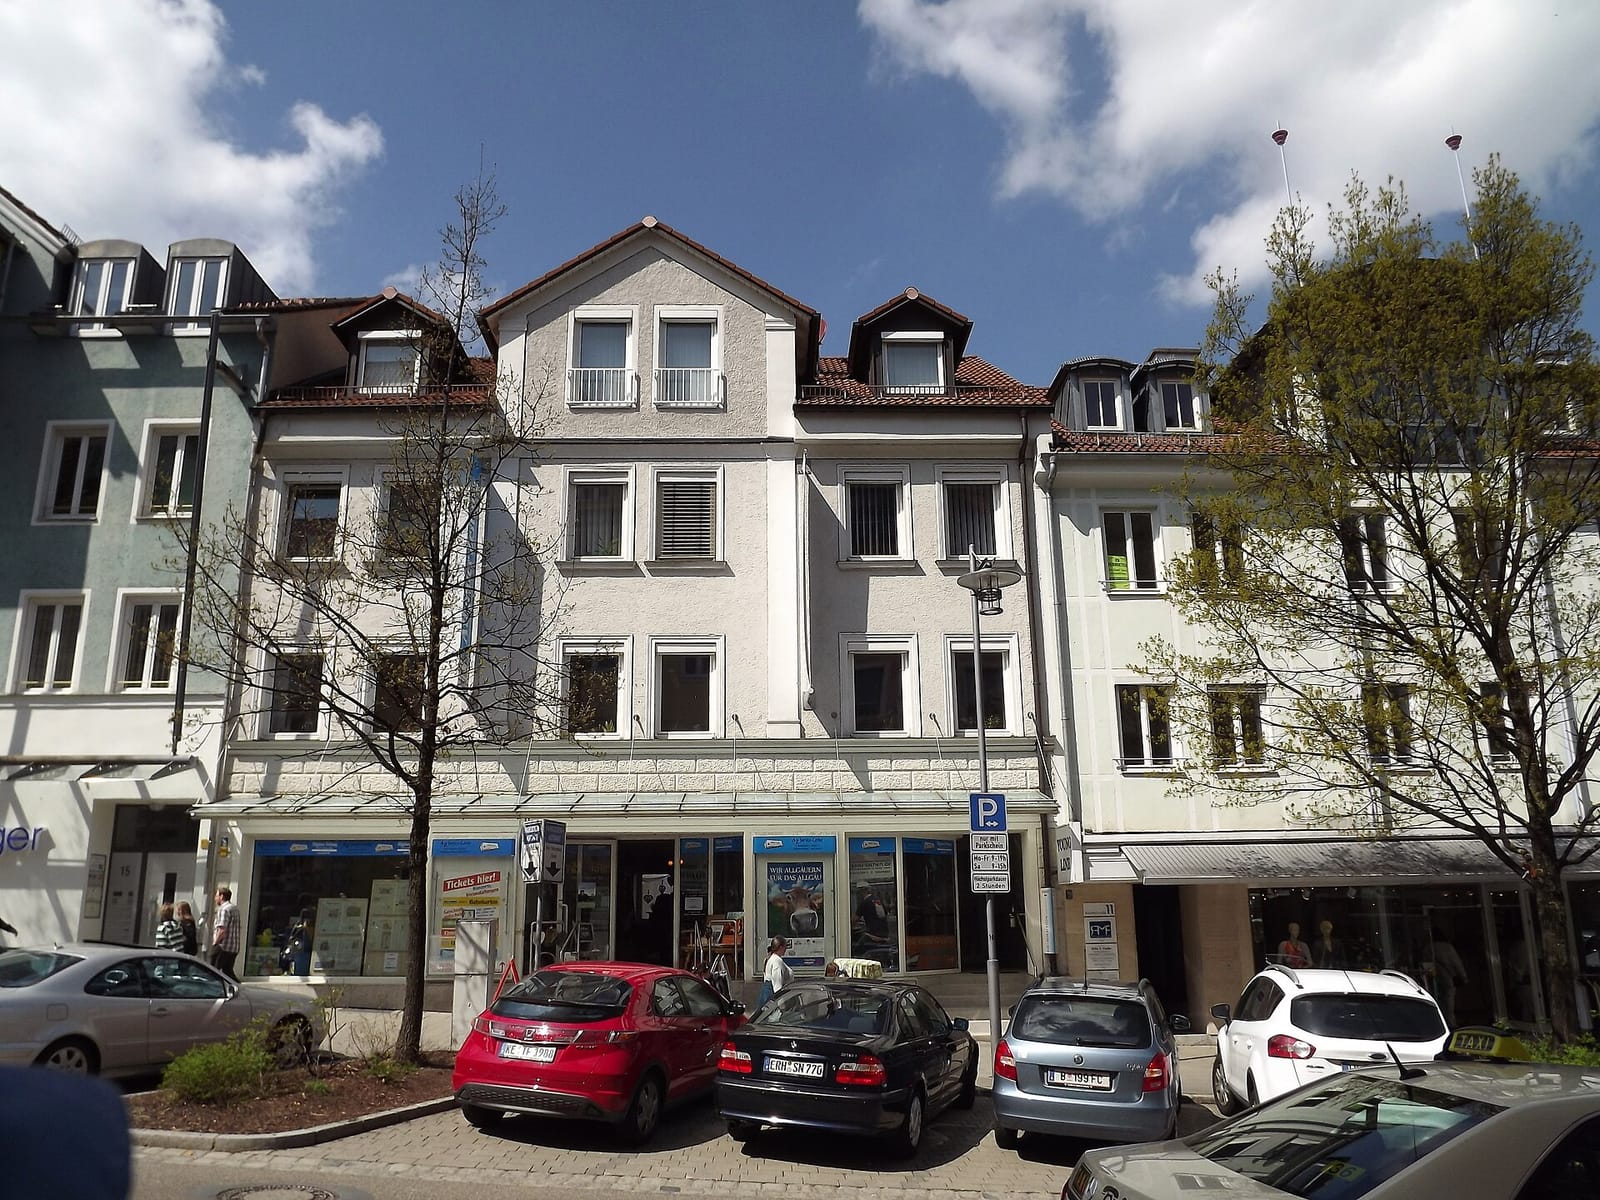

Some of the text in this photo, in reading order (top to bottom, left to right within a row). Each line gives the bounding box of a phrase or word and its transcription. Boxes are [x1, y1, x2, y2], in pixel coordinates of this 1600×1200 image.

[978, 797, 998, 827] P
[0, 827, 43, 855] er
[1056, 835, 1072, 851] YOUNG
[120, 865, 131, 877] 15
[446, 878, 475, 889] Tickets
[477, 872, 496, 884] hier!
[1105, 904, 1114, 915] 11
[1460, 1034, 1490, 1051] TAXI
[769, 1059, 788, 1072] ERH
[793, 1062, 805, 1073] SN
[1060, 1072, 1066, 1080] B
[1074, 1073, 1089, 1083] 199
